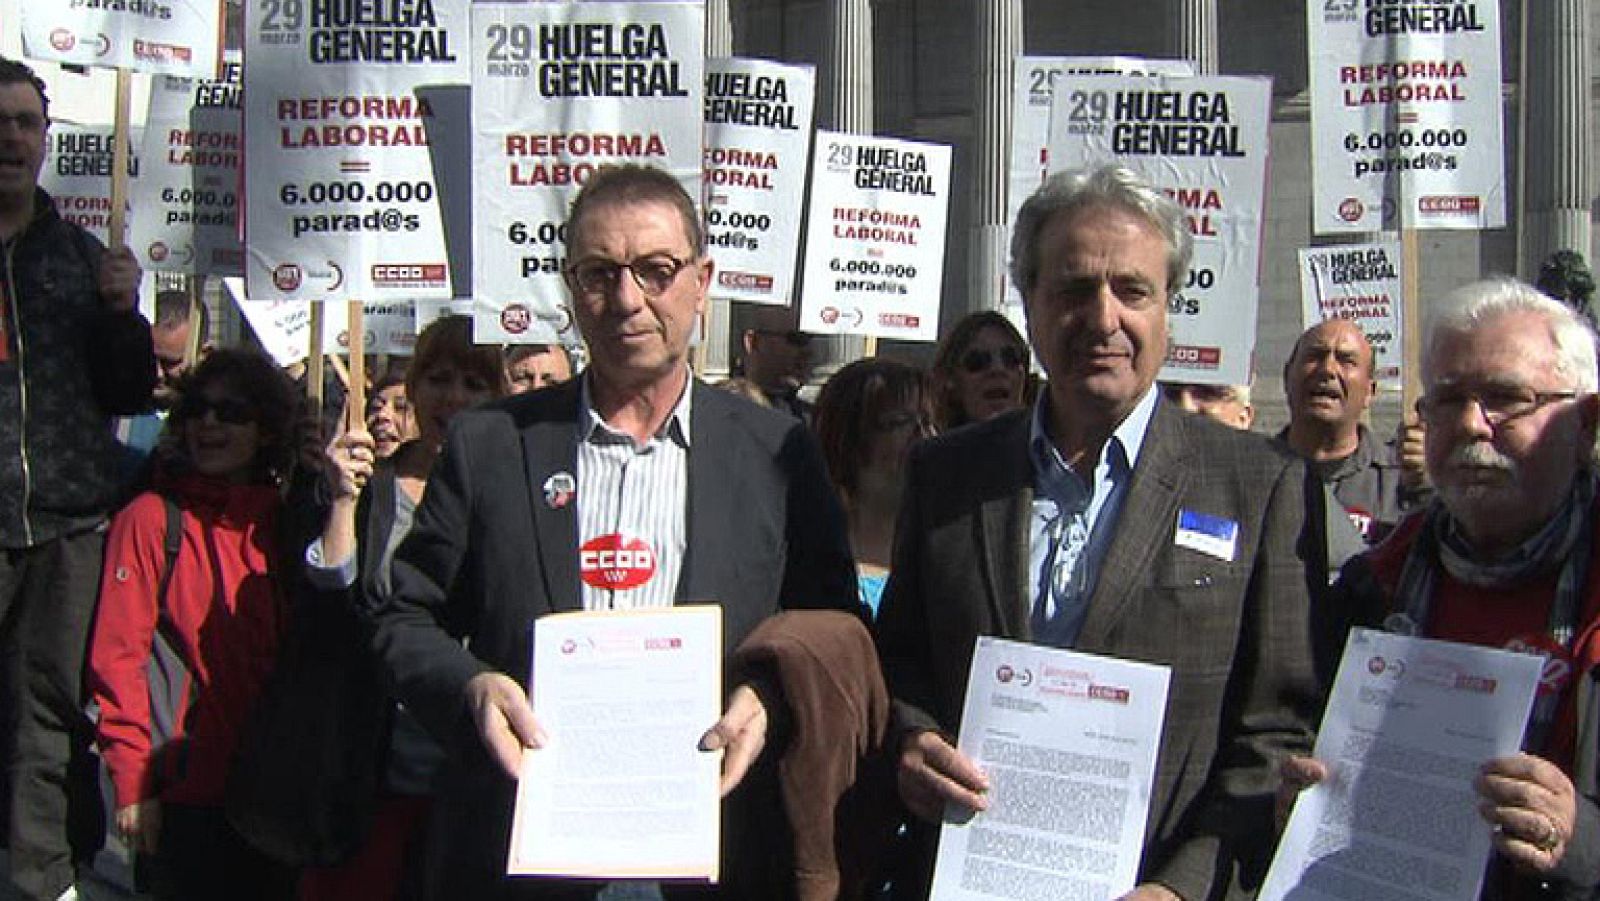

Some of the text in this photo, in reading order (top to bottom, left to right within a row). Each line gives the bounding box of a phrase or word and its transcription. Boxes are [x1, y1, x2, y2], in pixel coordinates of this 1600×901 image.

[260, 0, 437, 31] 29 HUELGA
[1366, 5, 1484, 37] GENERAL
[310, 30, 457, 63] GENERAL
[487, 24, 668, 60] 29 HUELGA
[538, 61, 689, 97] GENERAL
[1341, 61, 1467, 83] REFORMA
[1068, 91, 1229, 123] 29 HUELGA
[1344, 84, 1465, 107] LABORAL
[278, 96, 435, 119] REFORMA
[280, 124, 430, 147] LABORAL
[506, 134, 666, 157] REFORMA
[1112, 122, 1246, 157] GENERAL
[1344, 129, 1468, 152] 6.000.000
[828, 142, 927, 173] 29 HUELGA
[1356, 152, 1457, 179] parad@s
[511, 163, 594, 186] LABO
[855, 168, 936, 197] GENERAL
[280, 181, 432, 205] 6.000.000
[293, 209, 420, 238] parad@s
[833, 207, 921, 229] REFORMA
[833, 225, 918, 245] LABORAL
[829, 257, 917, 279] 6.000.000
[1331, 249, 1388, 268] HUELGA
[1332, 264, 1398, 284] GENERAL
[581, 550, 650, 570] CCOO
